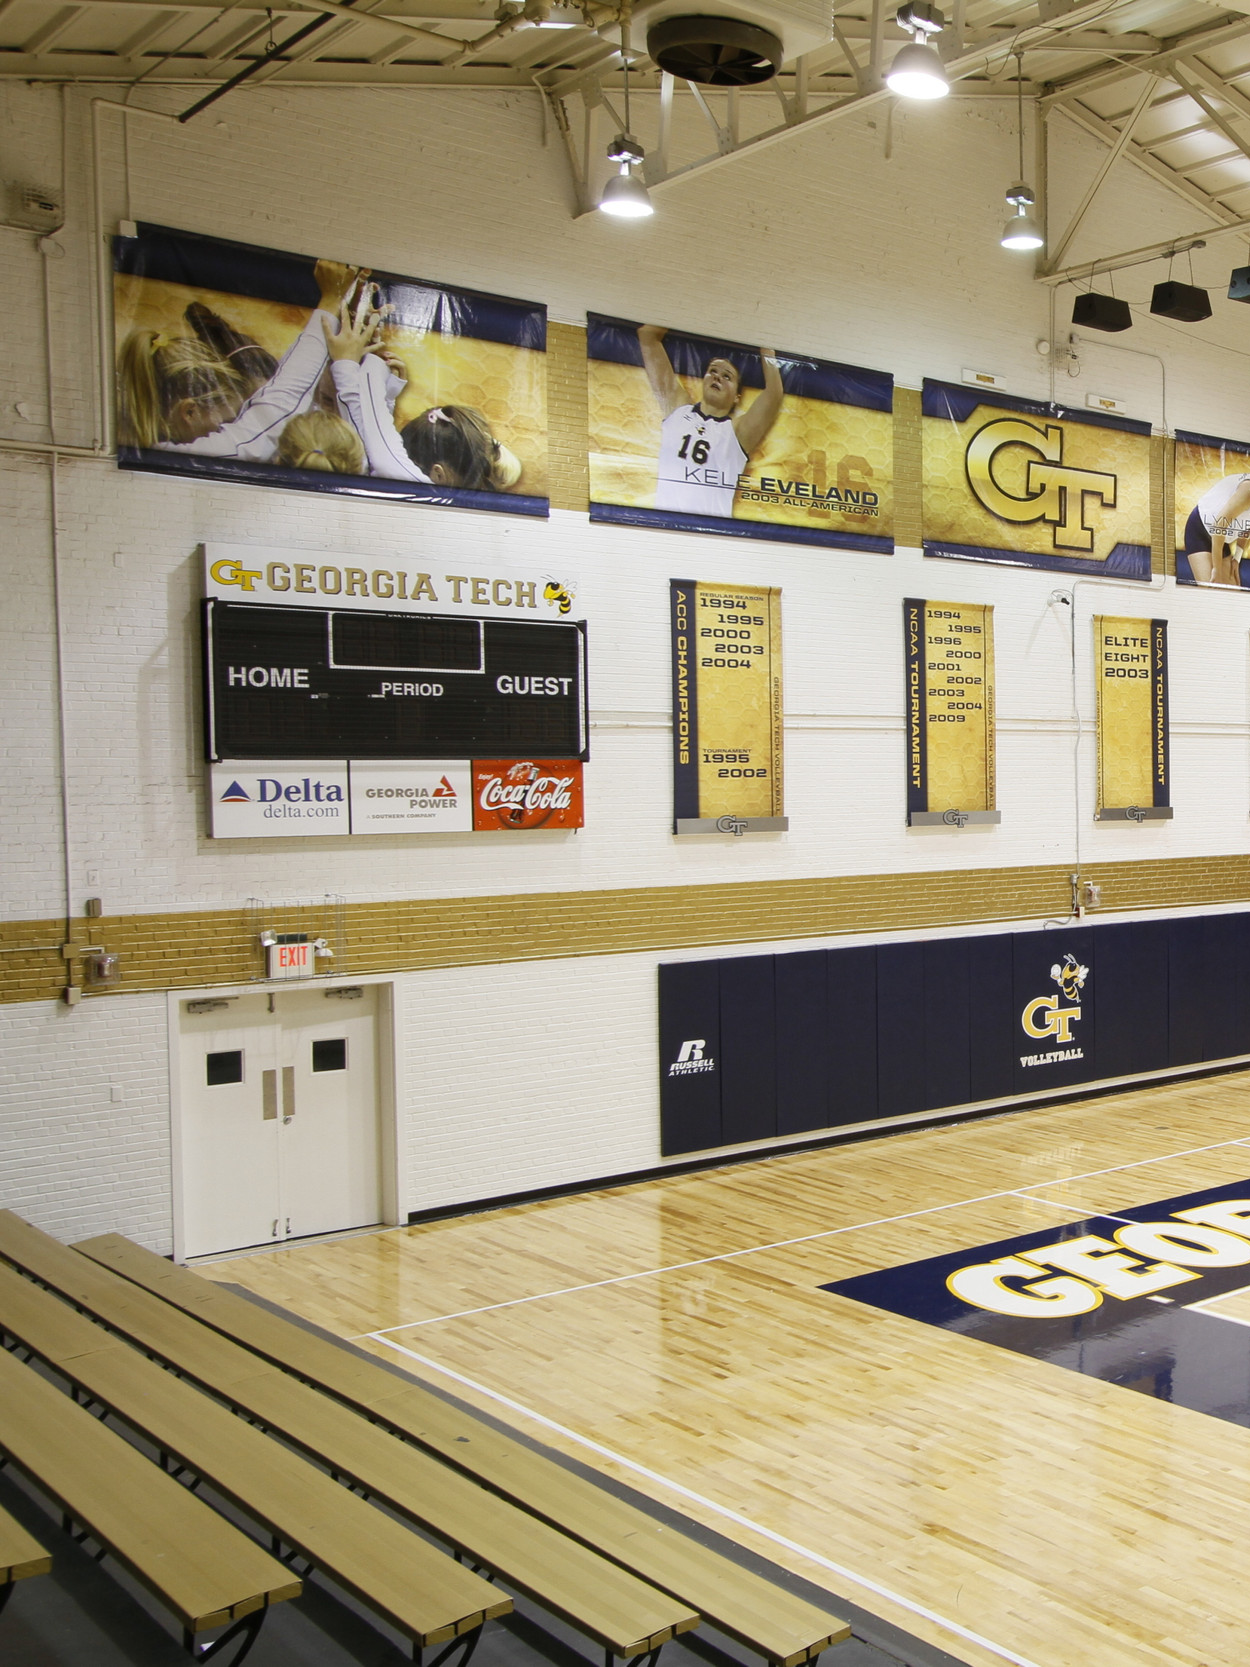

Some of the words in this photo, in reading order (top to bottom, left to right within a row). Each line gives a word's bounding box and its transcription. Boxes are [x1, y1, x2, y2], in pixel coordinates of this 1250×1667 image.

[677, 434, 712, 464] 16
[684, 466, 751, 489] KELE
[760, 477, 879, 506] EVELAND
[965, 418, 1117, 552] GT
[741, 492, 780, 504] 2003
[782, 497, 879, 517] ALL-AMERICAN
[210, 559, 263, 591] GT
[266, 561, 439, 602] GEORGIA
[445, 575, 538, 609] TECH
[677, 590, 687, 631] ACC
[700, 597, 747, 610] 1994
[718, 614, 764, 626] 1995
[927, 610, 961, 619] 1994
[701, 628, 751, 639] 2000
[910, 608, 919, 656] NCAA
[948, 624, 982, 634] 1995
[928, 636, 962, 645] 1996
[1104, 636, 1149, 648] ELITE
[715, 643, 764, 655] 2003
[946, 650, 982, 659] 2000
[702, 657, 751, 669] 2004
[1104, 652, 1149, 663] EIGHT
[928, 662, 962, 671] 2001
[1104, 667, 1149, 679] 2003
[228, 665, 310, 688] HOME
[946, 676, 982, 684] 2002
[381, 682, 444, 697] PERIOD
[496, 675, 573, 696] GUEST
[928, 688, 965, 697] 2003
[677, 636, 690, 765] CHAMPIONS
[947, 702, 983, 710] 2004
[910, 661, 921, 788] TOURNAMENT
[928, 714, 966, 722] 2009
[1156, 673, 1165, 785] TOURNAMENT
[703, 754, 750, 763] 1995
[718, 768, 767, 778] 2002
[257, 778, 345, 803] Delta
[365, 788, 429, 798] GEORGIA
[480, 776, 575, 811] Coca-Cola
[409, 798, 458, 809] POWER
[263, 804, 340, 818] delta.com
[1126, 806, 1146, 823] GT
[717, 815, 748, 836] GT
[943, 809, 968, 828] GT
[279, 945, 308, 968] EXIT
[1021, 994, 1082, 1044] GT
[669, 1058, 715, 1072] RUSSELL
[1020, 1048, 1084, 1068] VOLLEYBALL
[668, 1065, 715, 1077] ATHLETIC
